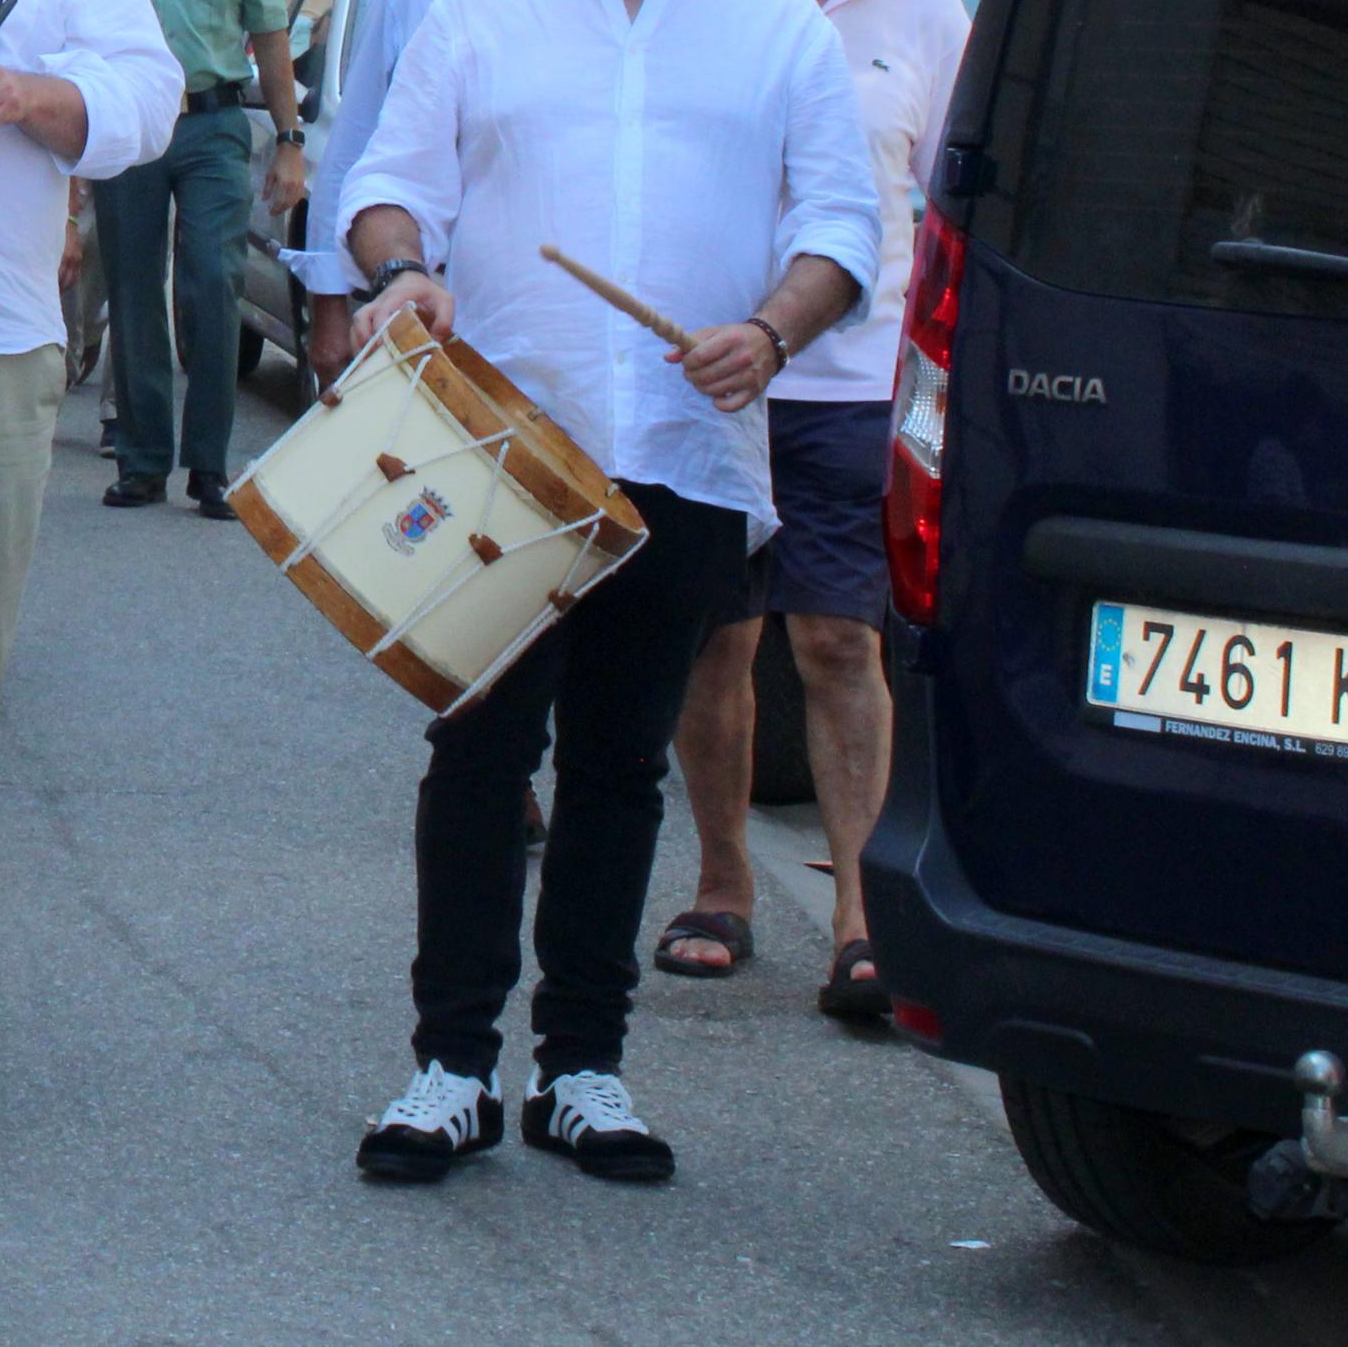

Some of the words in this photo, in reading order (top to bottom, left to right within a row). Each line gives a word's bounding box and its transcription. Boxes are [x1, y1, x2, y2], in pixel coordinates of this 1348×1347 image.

[1008, 368, 1107, 404] DACIA
[1099, 663, 1114, 686] E
[1138, 620, 1294, 718] 7461
[1165, 719, 1231, 742] FERNANDEZ
